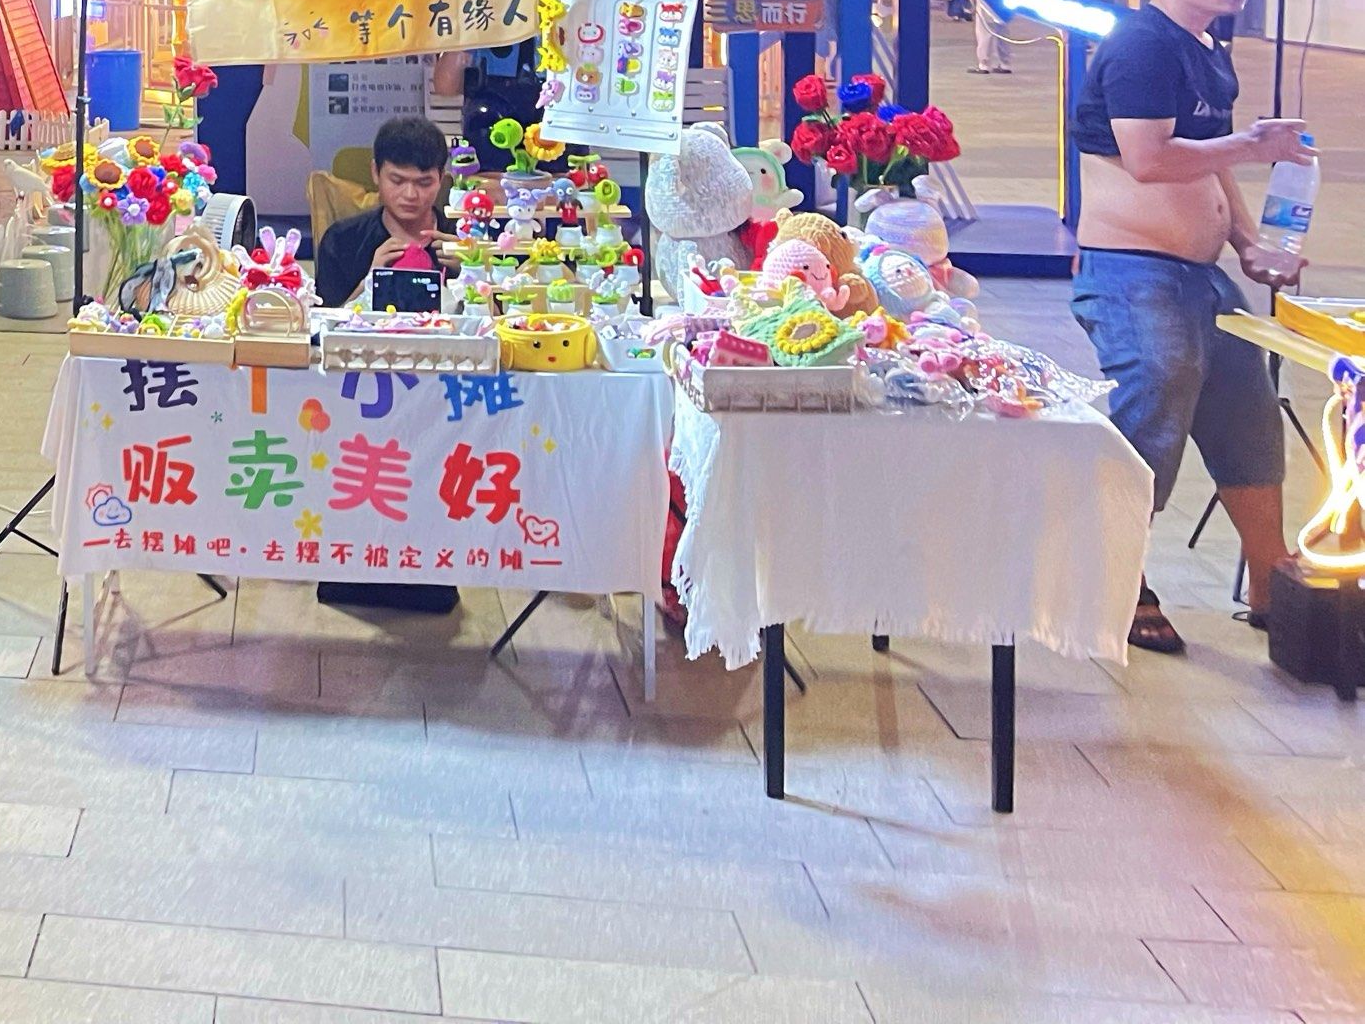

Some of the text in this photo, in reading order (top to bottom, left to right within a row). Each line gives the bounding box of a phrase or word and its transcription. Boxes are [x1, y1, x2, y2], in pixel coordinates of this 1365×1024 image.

[705, 0, 808, 24] 三思而行
[122, 430, 521, 525] 贩卖美好
